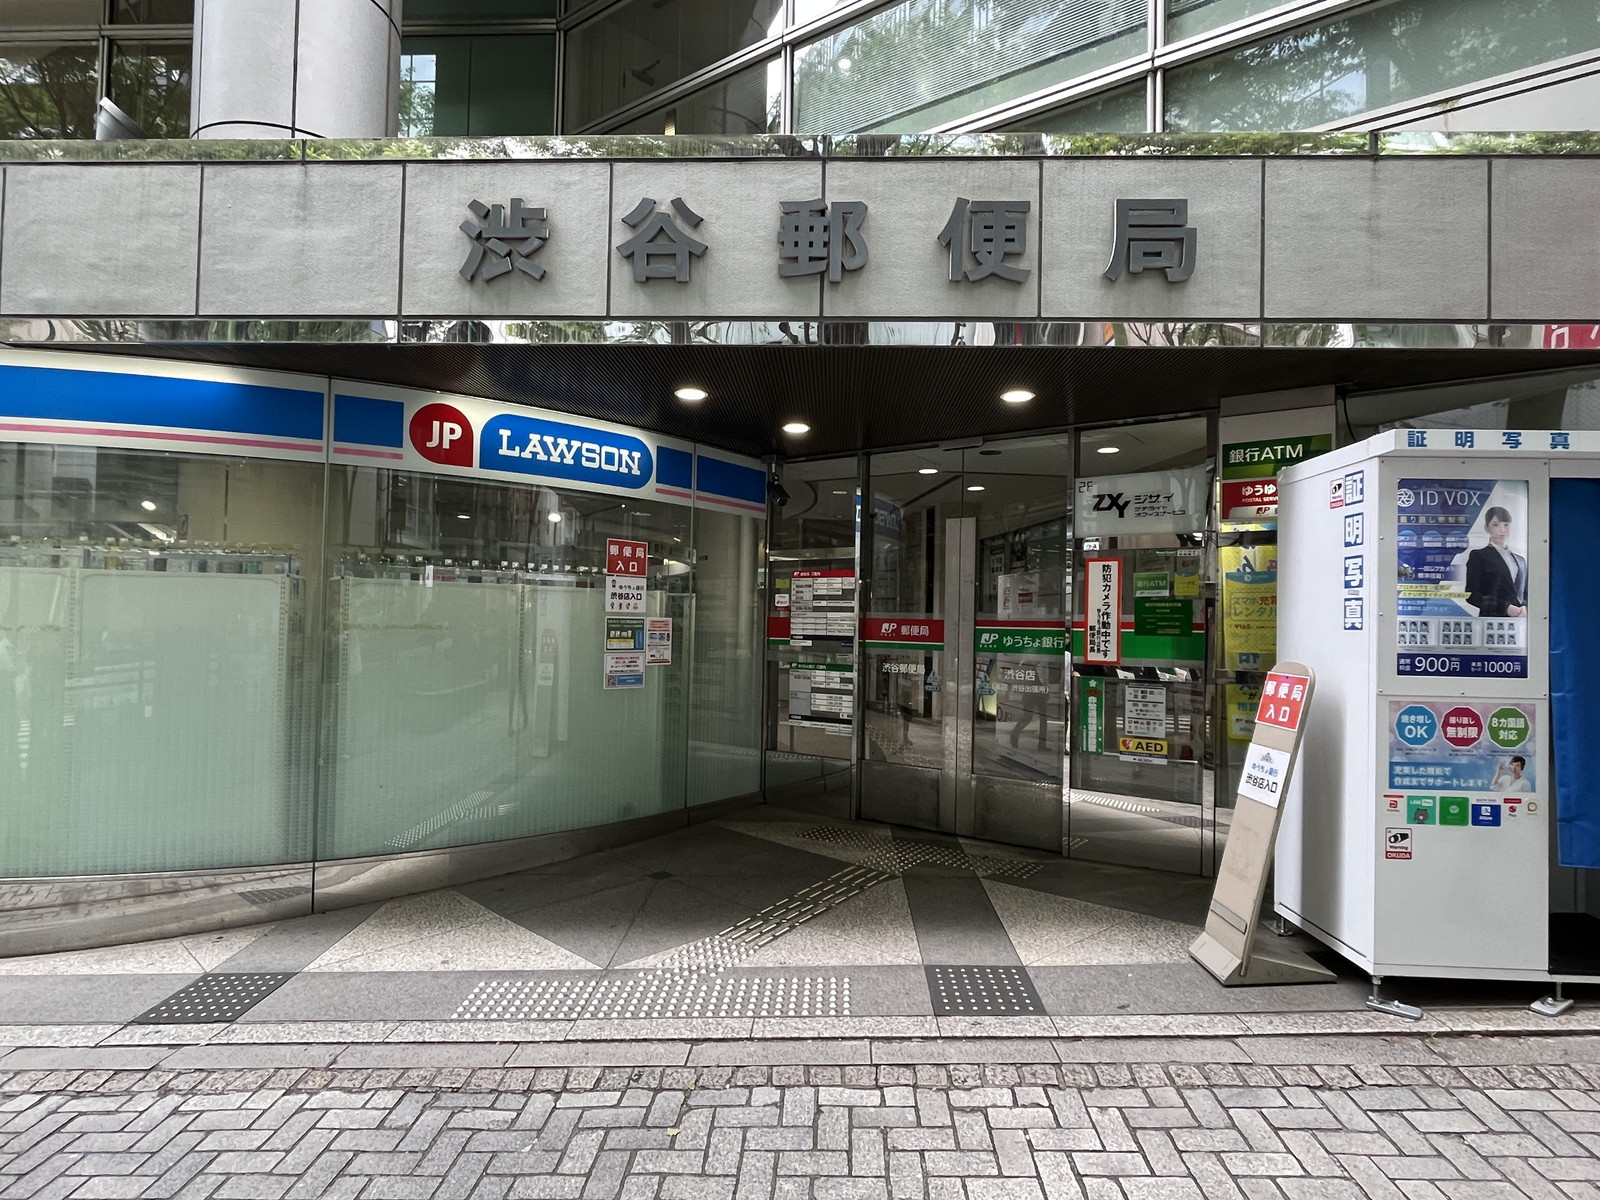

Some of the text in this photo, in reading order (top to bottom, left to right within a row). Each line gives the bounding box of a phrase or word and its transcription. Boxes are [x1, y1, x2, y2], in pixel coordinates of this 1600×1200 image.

[458, 197, 1198, 283] 渋谷郵便局
[426, 420, 463, 450] JP
[1408, 430, 1570, 450] 証明写真
[498, 429, 641, 475] LAWSON
[1229, 444, 1303, 463] 銀行ATM
[1242, 483, 1279, 497] ゆうゆ
[1093, 493, 1131, 518] ZXY
[1420, 491, 1481, 507] ID VOX
[609, 545, 645, 559] 郵便局
[1344, 471, 1364, 630] 証明写真
[616, 561, 638, 572] 入口
[1101, 564, 1112, 658] 防犯カメラ作動中です
[901, 625, 930, 636] 郵便局
[981, 633, 998, 644] JP
[1003, 636, 1064, 648] ゆうちょ銀行
[882, 662, 926, 674] 渋谷郵便局
[1415, 657, 1460, 673] 900円
[1484, 661, 1521, 673] 1000円
[1004, 669, 1036, 681] 渋谷店
[1265, 681, 1304, 702] 郵便局
[1266, 704, 1290, 723] 入口
[1401, 715, 1432, 724] 焼き増し
[1491, 717, 1525, 729] 8カ国語
[1404, 726, 1428, 739] OK
[1446, 727, 1479, 739] 無制限
[1498, 730, 1518, 741] 対応
[1135, 741, 1164, 753] AED
[1245, 773, 1278, 793] 渋谷店入口
